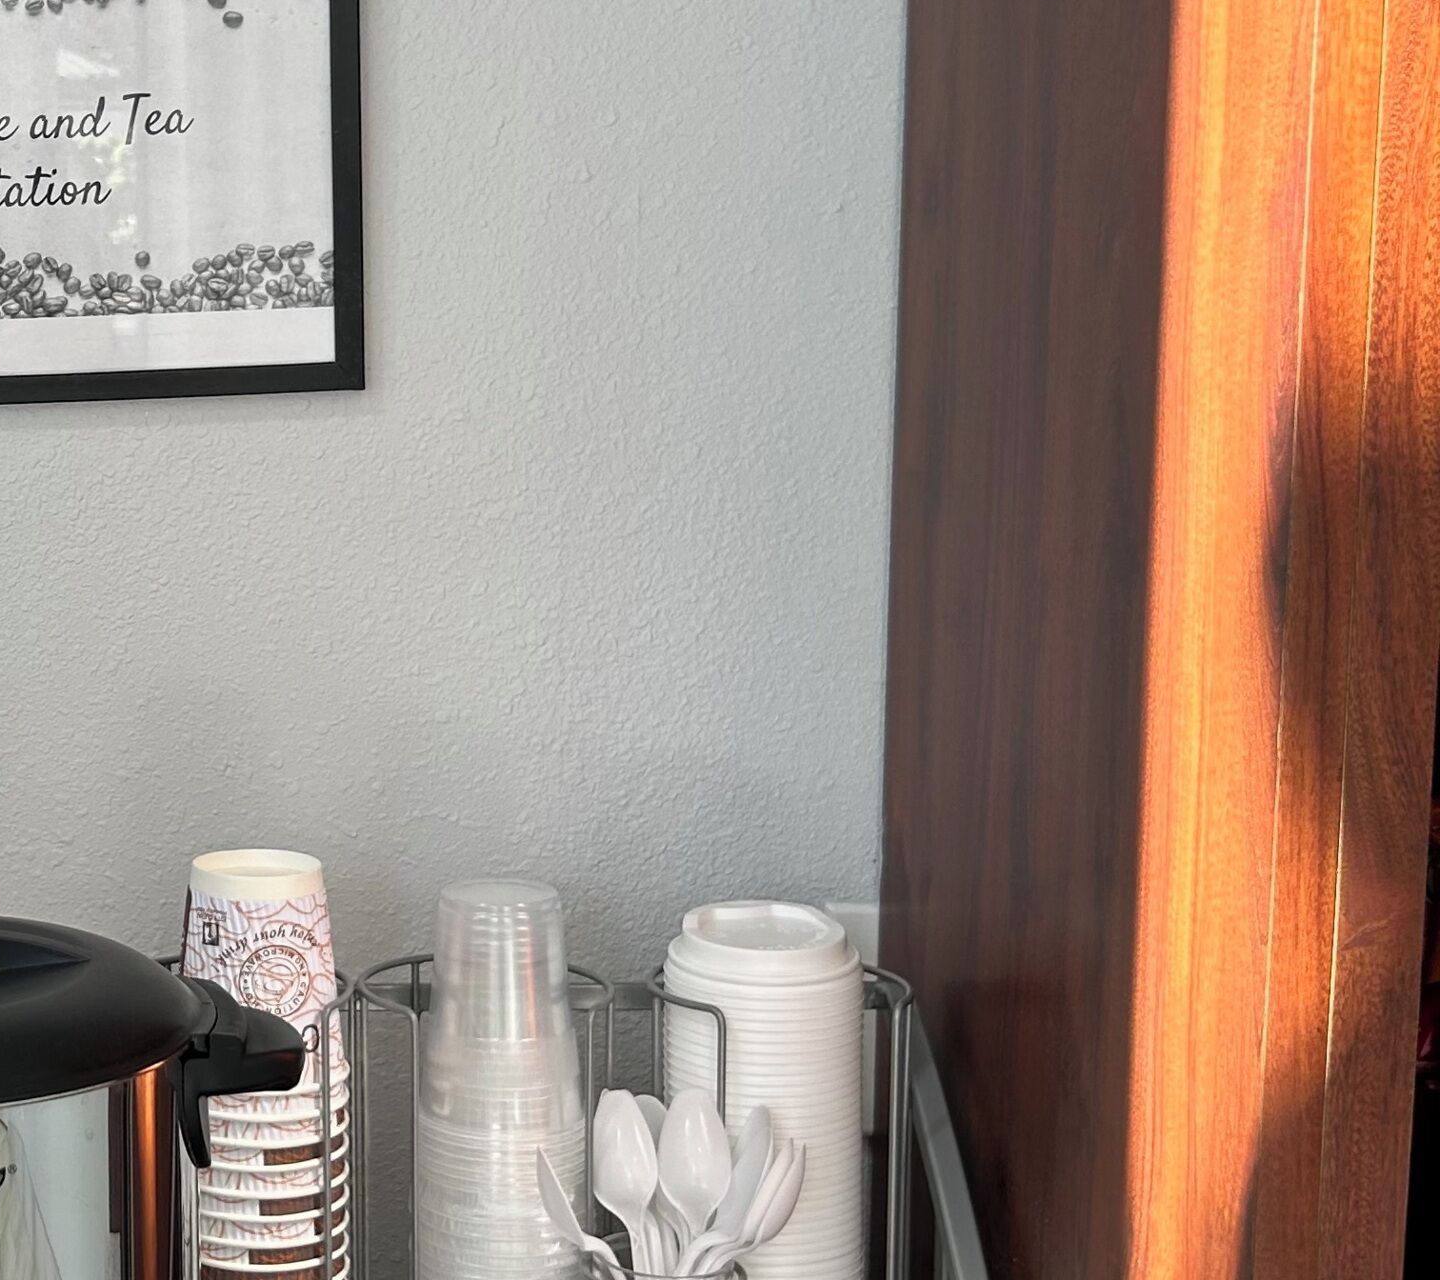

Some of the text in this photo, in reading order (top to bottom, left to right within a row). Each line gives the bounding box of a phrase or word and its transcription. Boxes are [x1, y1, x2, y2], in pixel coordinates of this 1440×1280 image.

[29, 96, 111, 139] and
[121, 92, 195, 146] Tea
[253, 925, 286, 943] your
